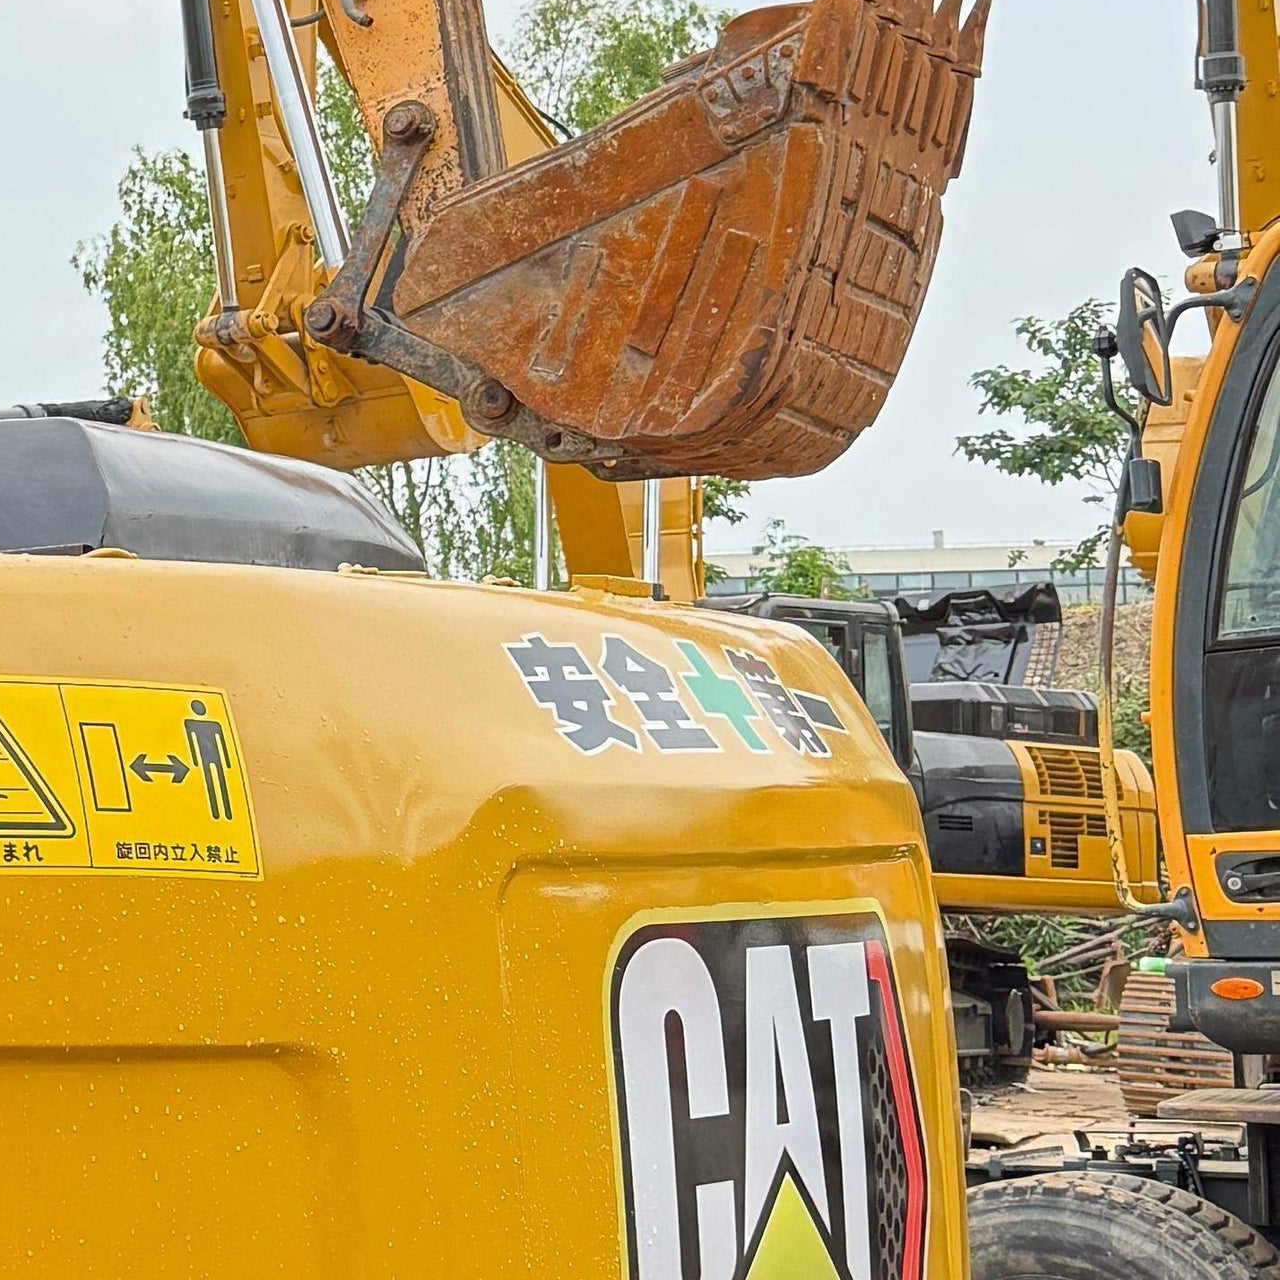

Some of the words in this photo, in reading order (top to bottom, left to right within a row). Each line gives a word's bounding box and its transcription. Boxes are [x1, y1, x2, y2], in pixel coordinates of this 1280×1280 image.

[115, 842, 240, 864] 旋回内立入禁止
